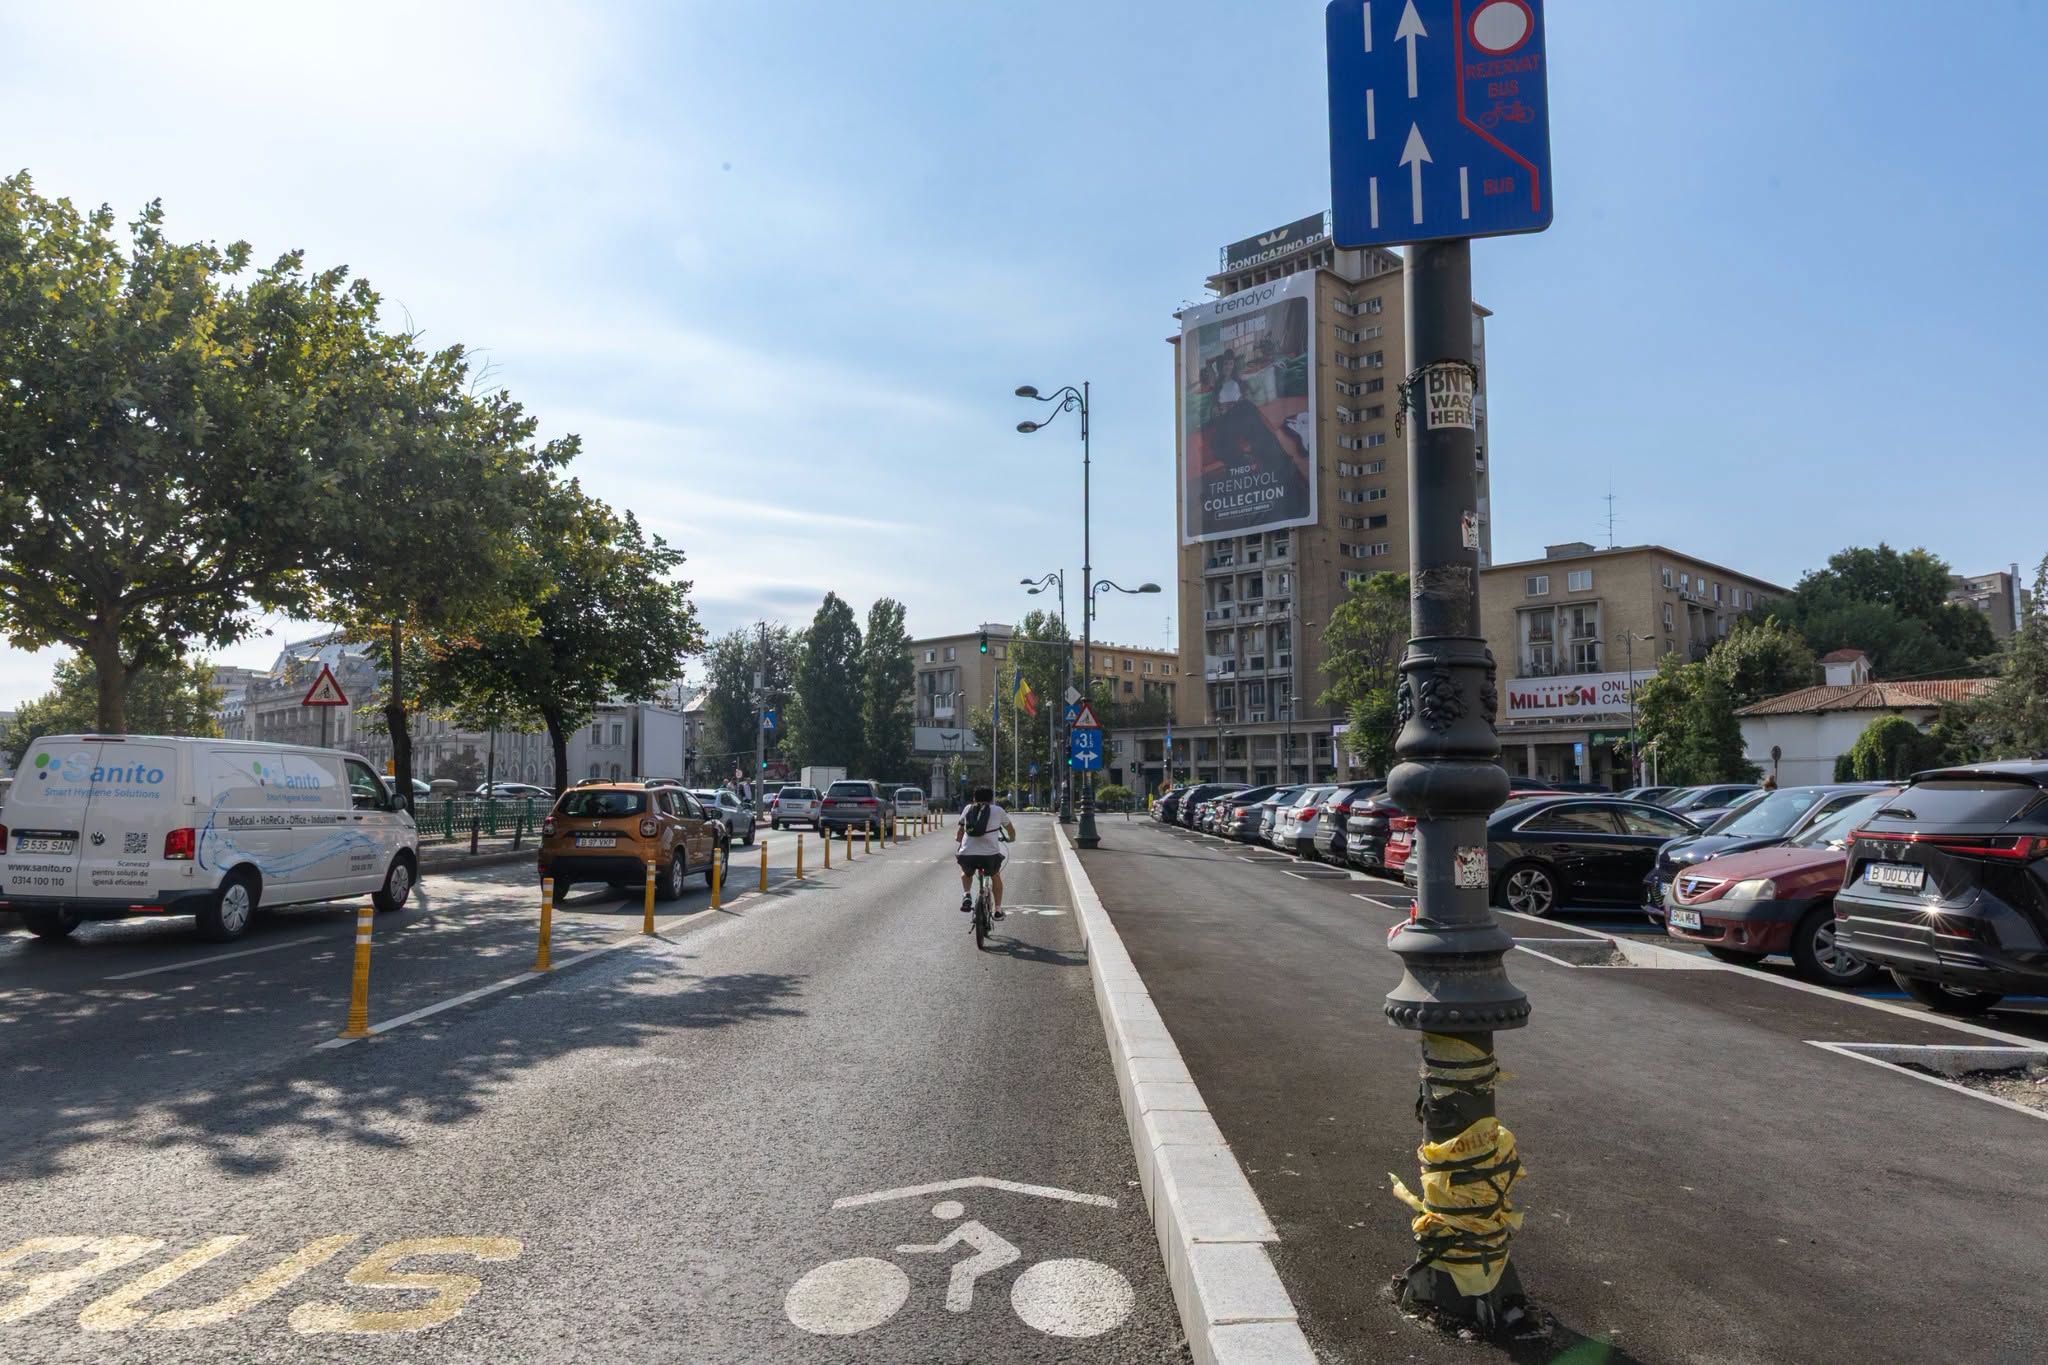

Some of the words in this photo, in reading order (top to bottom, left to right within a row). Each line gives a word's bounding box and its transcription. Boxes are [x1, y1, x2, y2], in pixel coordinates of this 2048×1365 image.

[1465, 55, 1540, 80] REZERVAT
[1488, 80, 1519, 98] BUS
[1484, 177, 1515, 195] BUS
[1229, 232, 1324, 271] CONTICAZINO.RO
[1215, 284, 1276, 314] trendyol
[1430, 394, 1472, 409] WAS
[1230, 465, 1251, 476] THEO
[1208, 471, 1279, 495] TRENDYOL
[1204, 485, 1284, 511] COLLECTION
[62, 752, 165, 784] Sanito
[45, 787, 72, 797] Smart
[74, 788, 112, 799] Hygiene
[114, 789, 160, 799] Solutions
[228, 816, 255, 826] Medical
[260, 815, 285, 825] HoReCa
[289, 815, 306, 825] Office
[22, 840, 29, 850] B
[30, 840, 48, 850] 535
[51, 840, 73, 850] SAN
[8, 863, 73, 874] www.sanito.ro
[92, 870, 115, 878] pentru
[139, 870, 149, 878] de
[1872, 866, 1880, 879] B
[12, 876, 32, 885] 0314
[33, 877, 49, 886] 100
[51, 878, 65, 886] 110
